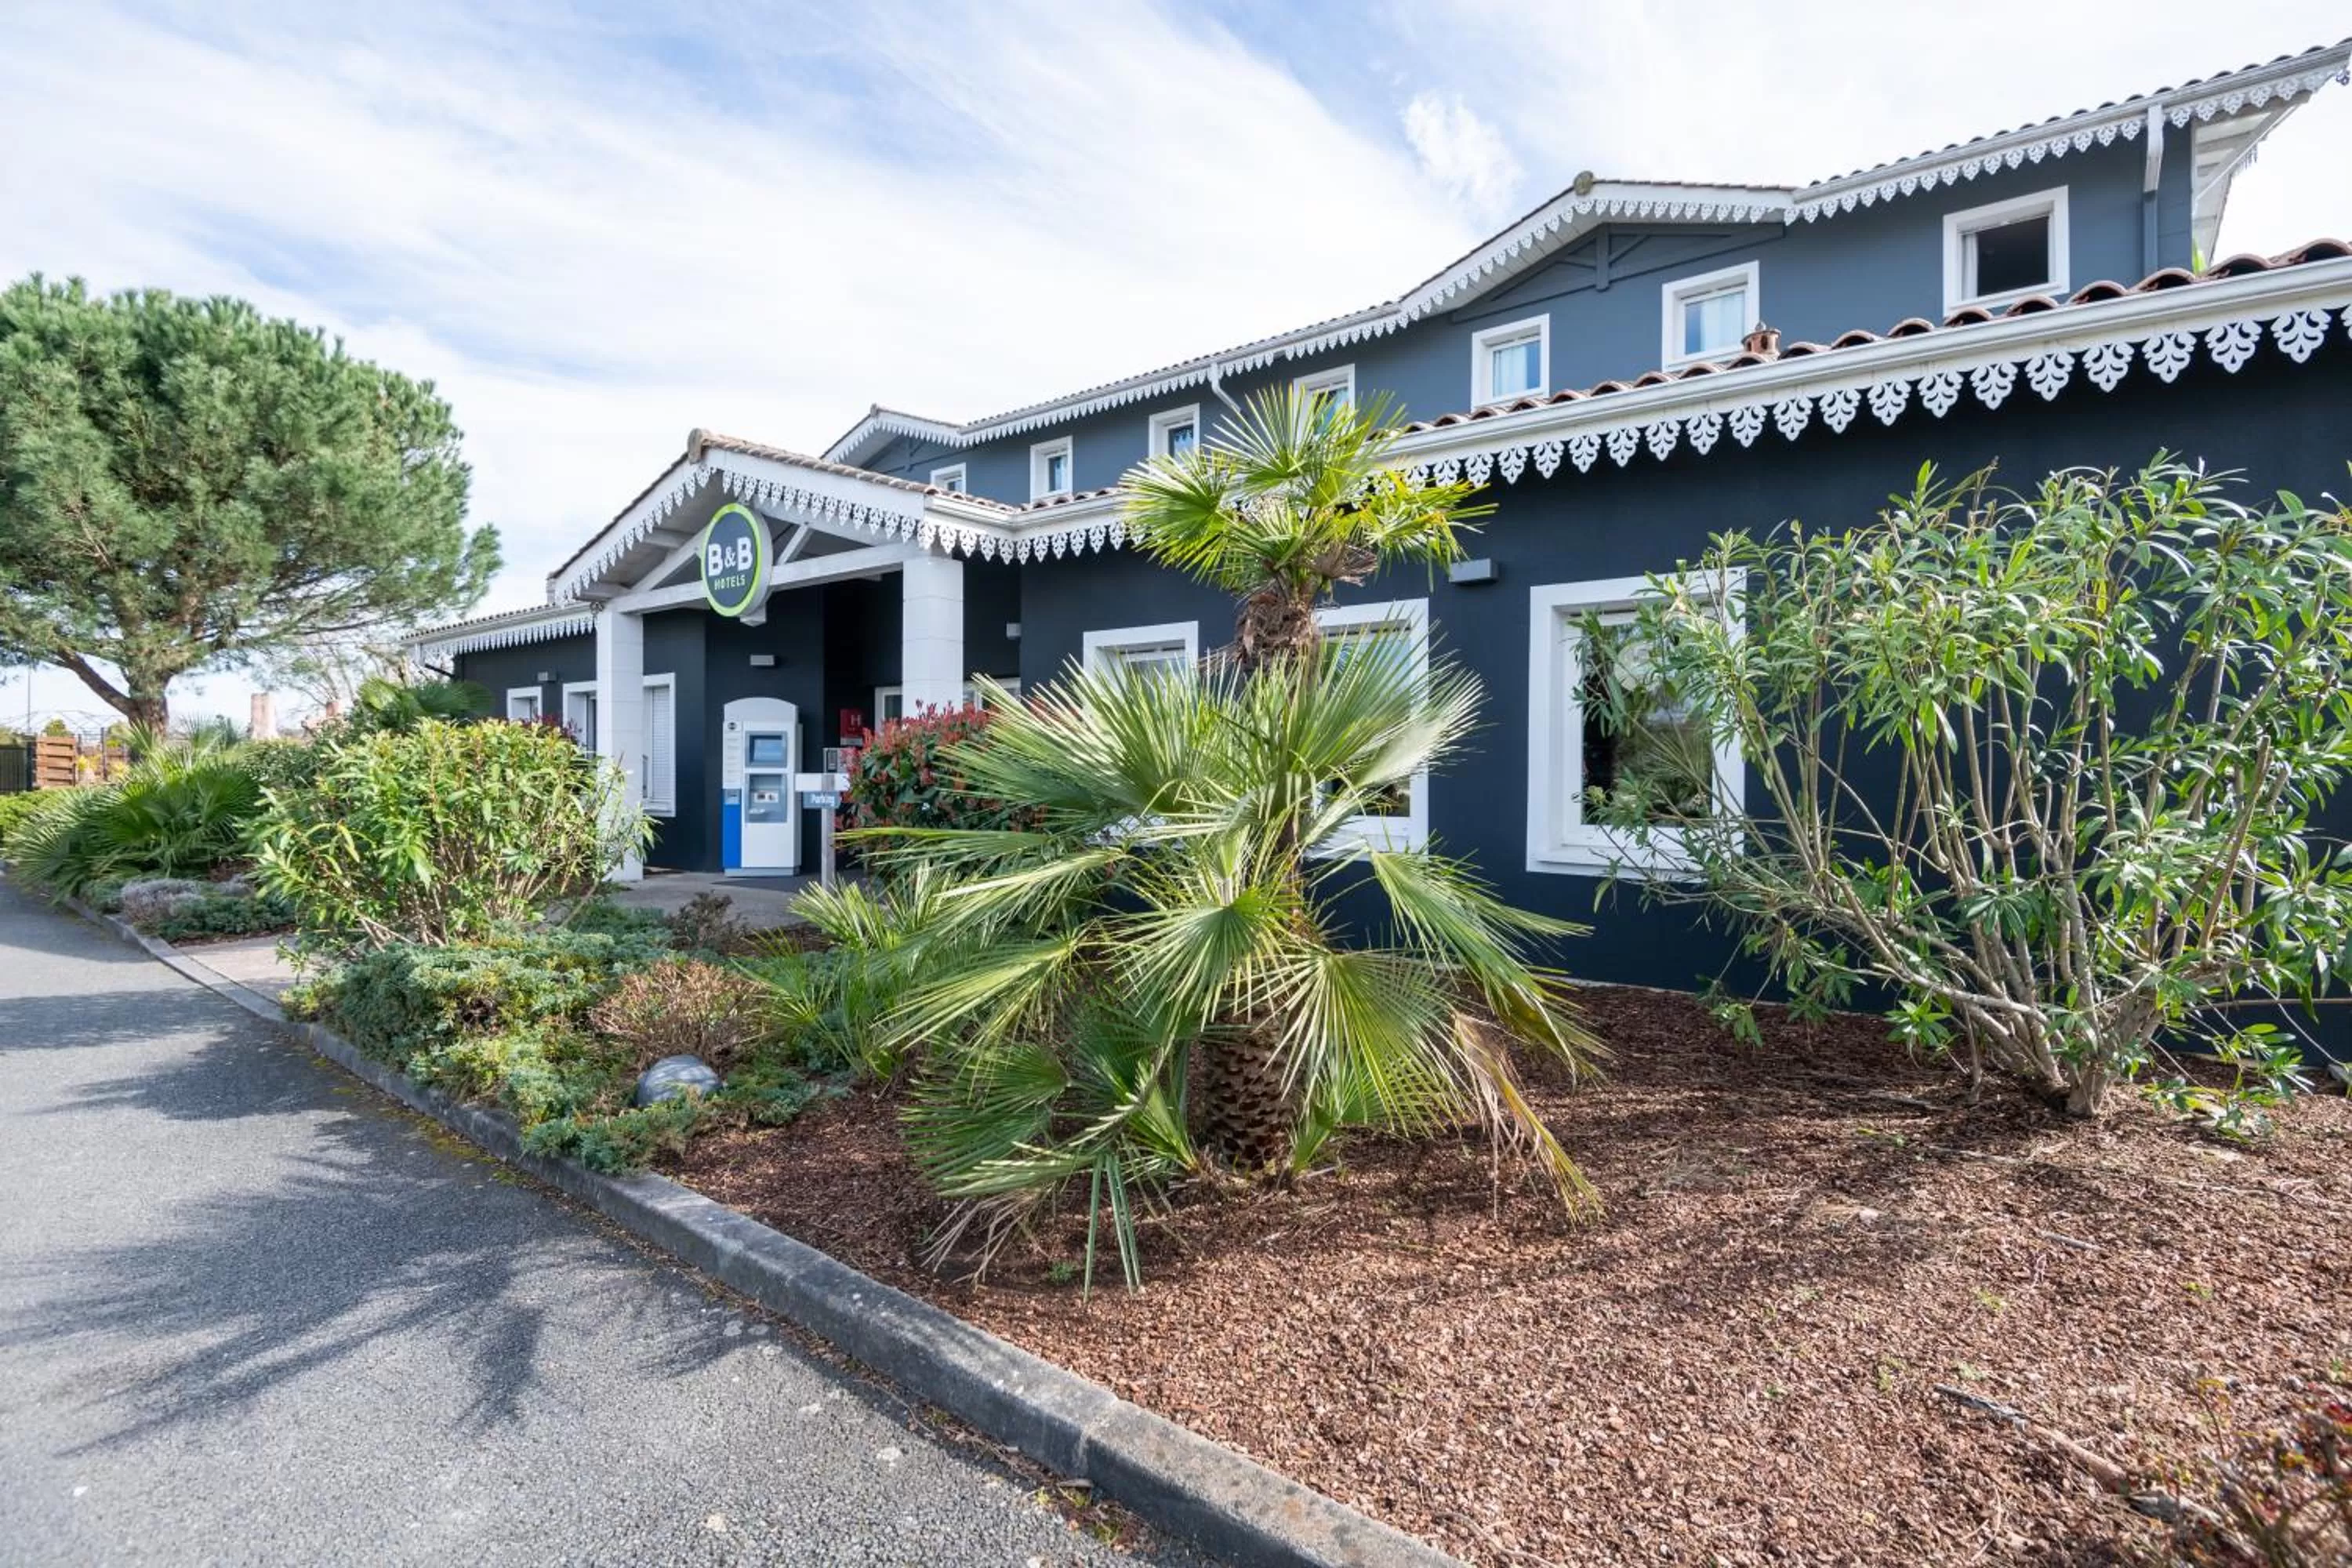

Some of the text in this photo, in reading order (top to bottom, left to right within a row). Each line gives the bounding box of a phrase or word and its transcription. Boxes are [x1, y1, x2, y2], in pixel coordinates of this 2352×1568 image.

[708, 537, 753, 577] B&B
[714, 574, 746, 590] HOTELS
[851, 714, 862, 726] H
[811, 793, 835, 807] Parking
